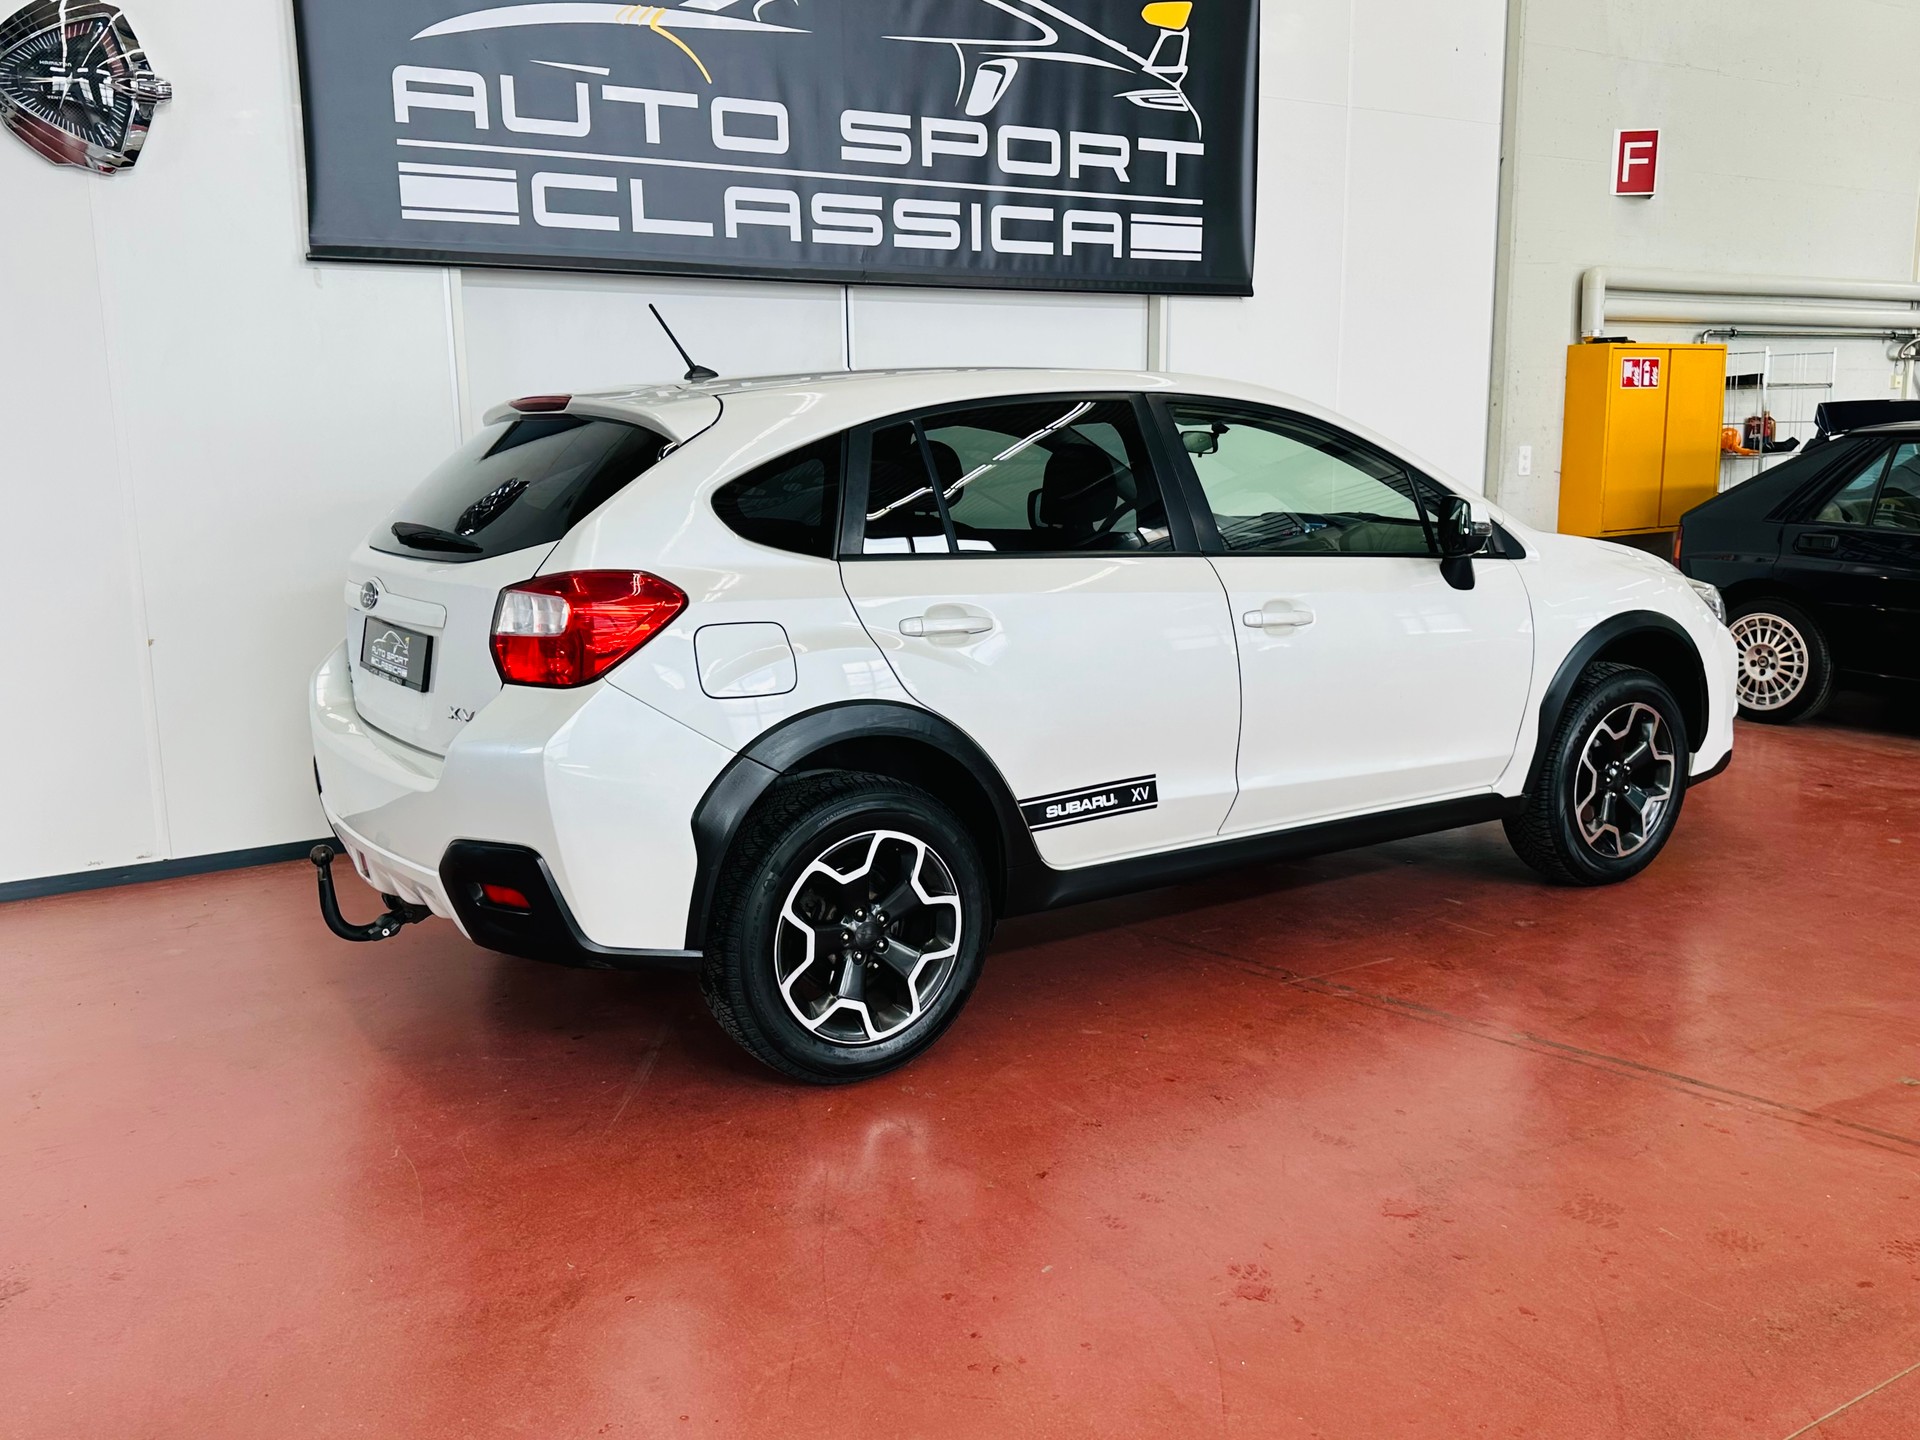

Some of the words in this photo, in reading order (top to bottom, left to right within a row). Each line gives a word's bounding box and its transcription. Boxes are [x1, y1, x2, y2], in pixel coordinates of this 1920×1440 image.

[391, 64, 790, 156] AUTO
[839, 108, 1205, 187] SPORT
[1622, 141, 1653, 182] F
[531, 171, 1123, 260] CLASSICA
[371, 645, 386, 658] AUTO
[386, 651, 409, 666] SPORT
[448, 705, 476, 723] XV
[1131, 786, 1149, 802] XV
